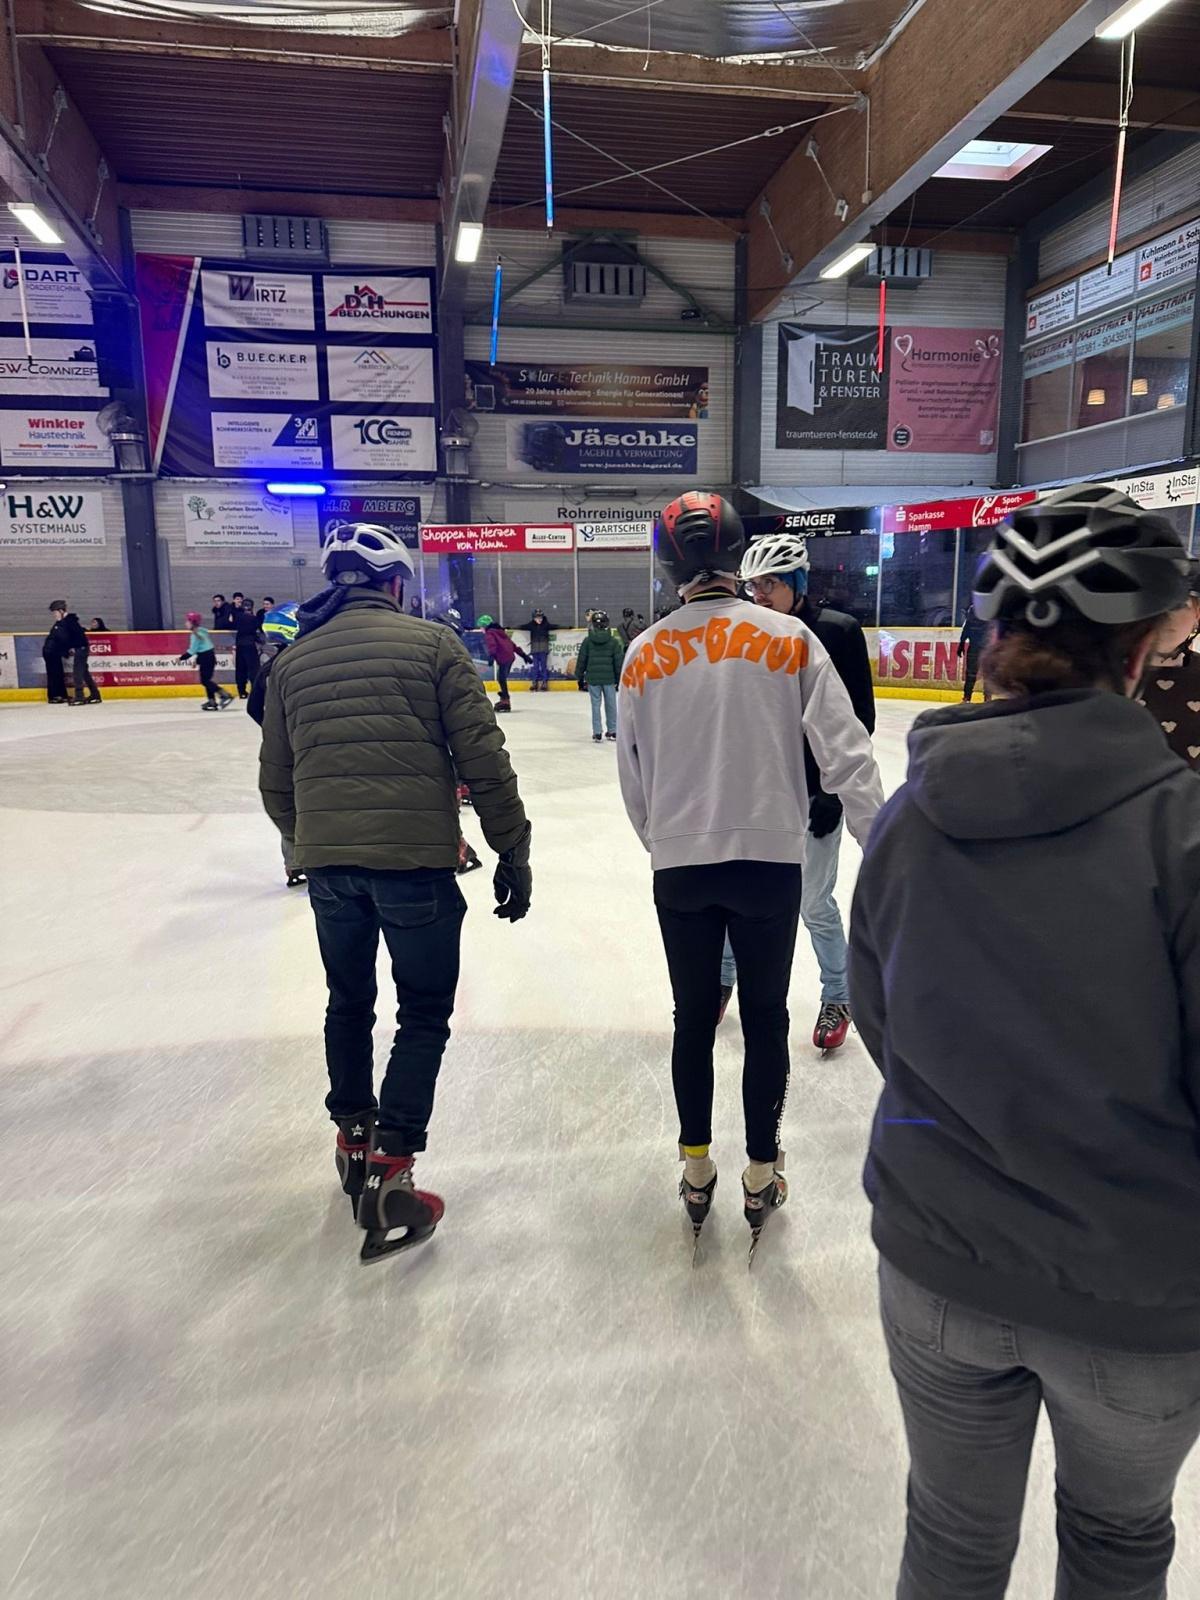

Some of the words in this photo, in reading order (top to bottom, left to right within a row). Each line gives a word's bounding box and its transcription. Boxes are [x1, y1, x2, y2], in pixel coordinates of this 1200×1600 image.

[25, 269, 81, 282] DART
[339, 309, 430, 319] BEDACHUNGEN
[912, 348, 981, 362] Harmonie
[614, 371, 651, 384] Hamm
[654, 373, 690, 386] GmbH
[819, 368, 880, 383] TÜREN
[525, 387, 535, 395] 20
[819, 385, 828, 397] &
[830, 386, 881, 398] FENSTER
[28, 418, 85, 430] Winkler
[28, 431, 86, 440] Haustechnik
[565, 428, 697, 447] Jäschke
[786, 430, 879, 439] traumtueren-fenster.de
[623, 449, 683, 458] VERWALTUNG
[1131, 480, 1155, 494] InSta
[1173, 474, 1197, 488] InSta
[1002, 496, 1022, 505] Sport-
[7, 495, 84, 519] H&W
[785, 514, 836, 528] SENGER
[908, 510, 945, 522] Sparkasse
[10, 523, 87, 534] SYSTEMHAUS
[595, 524, 647, 533] BARTSCHER
[908, 523, 932, 532] Hamm
[422, 528, 465, 542] Shoppen
[466, 527, 479, 539] im
[480, 527, 517, 539] Herzen
[456, 540, 474, 550] von
[474, 539, 508, 550] Hamm.
[119, 659, 143, 668] selbst
[145, 659, 155, 668] in
[156, 659, 170, 667] der
[878, 640, 968, 681] ISEN
[120, 675, 176, 684] www.frittgen.de
[351, 1151, 364, 1160] 44
